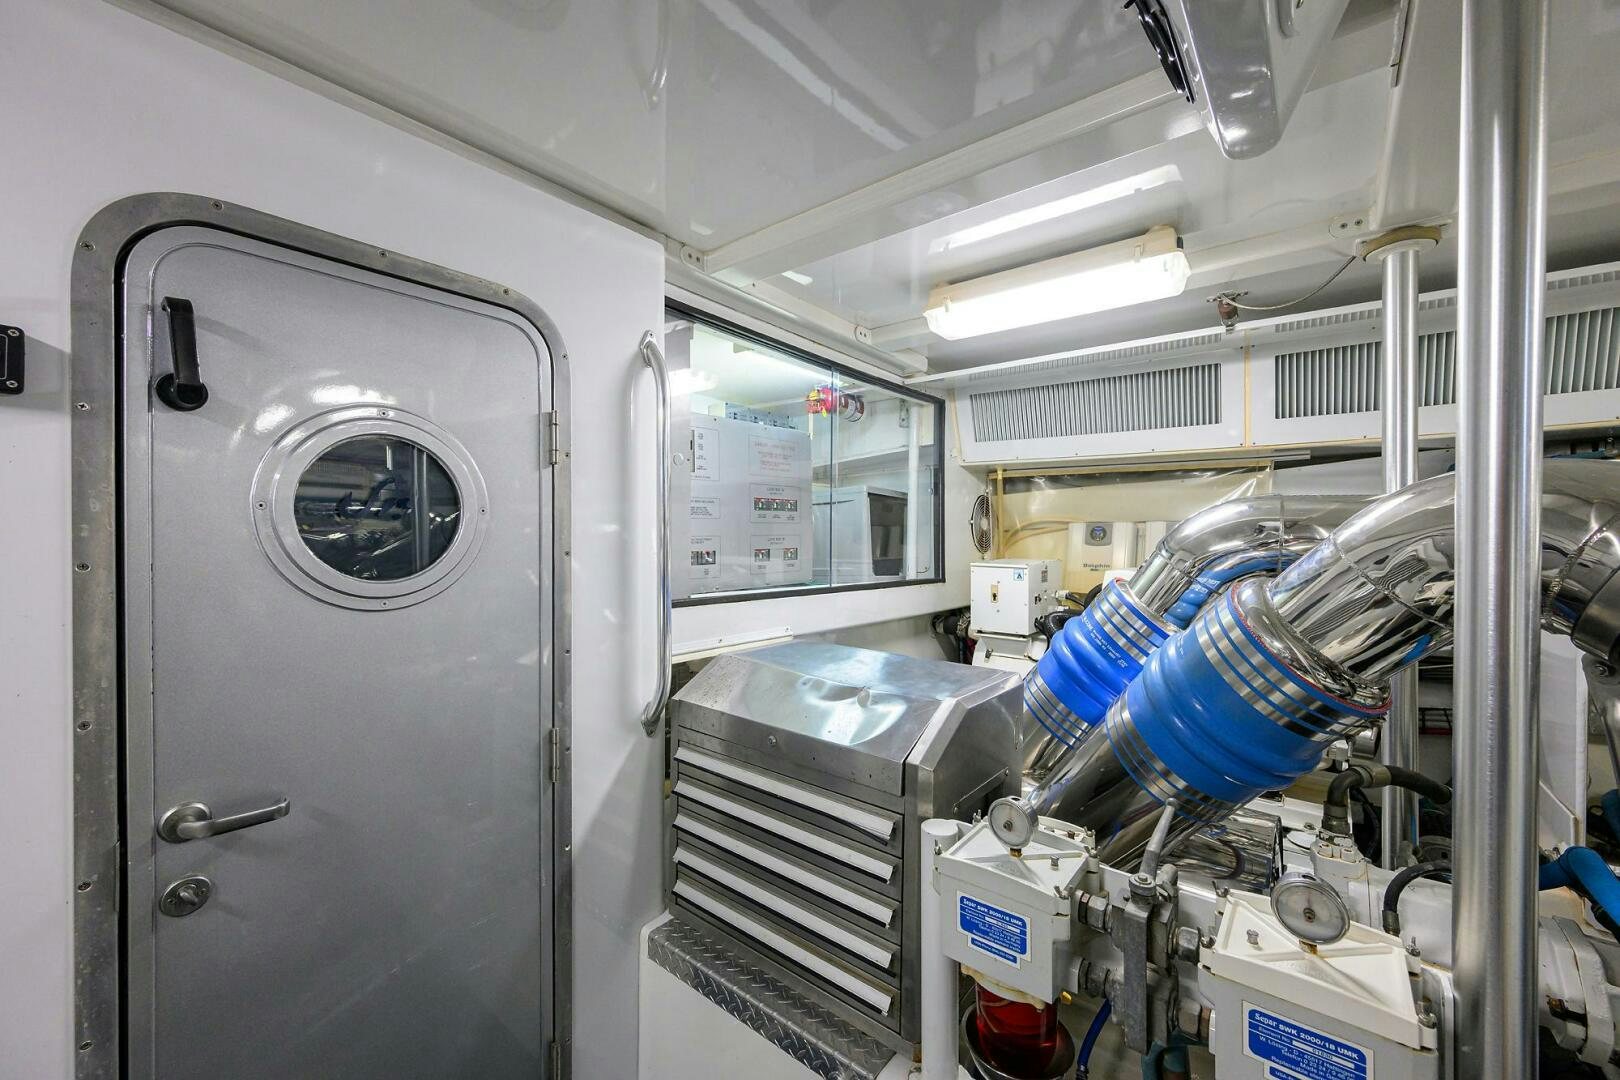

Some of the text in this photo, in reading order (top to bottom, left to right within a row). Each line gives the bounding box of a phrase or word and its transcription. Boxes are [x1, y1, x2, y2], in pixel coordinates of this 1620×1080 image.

[1254, 1012, 1278, 1027] Separ
[1279, 1023, 1298, 1037] SWK
[1337, 1047, 1359, 1060] UMK
